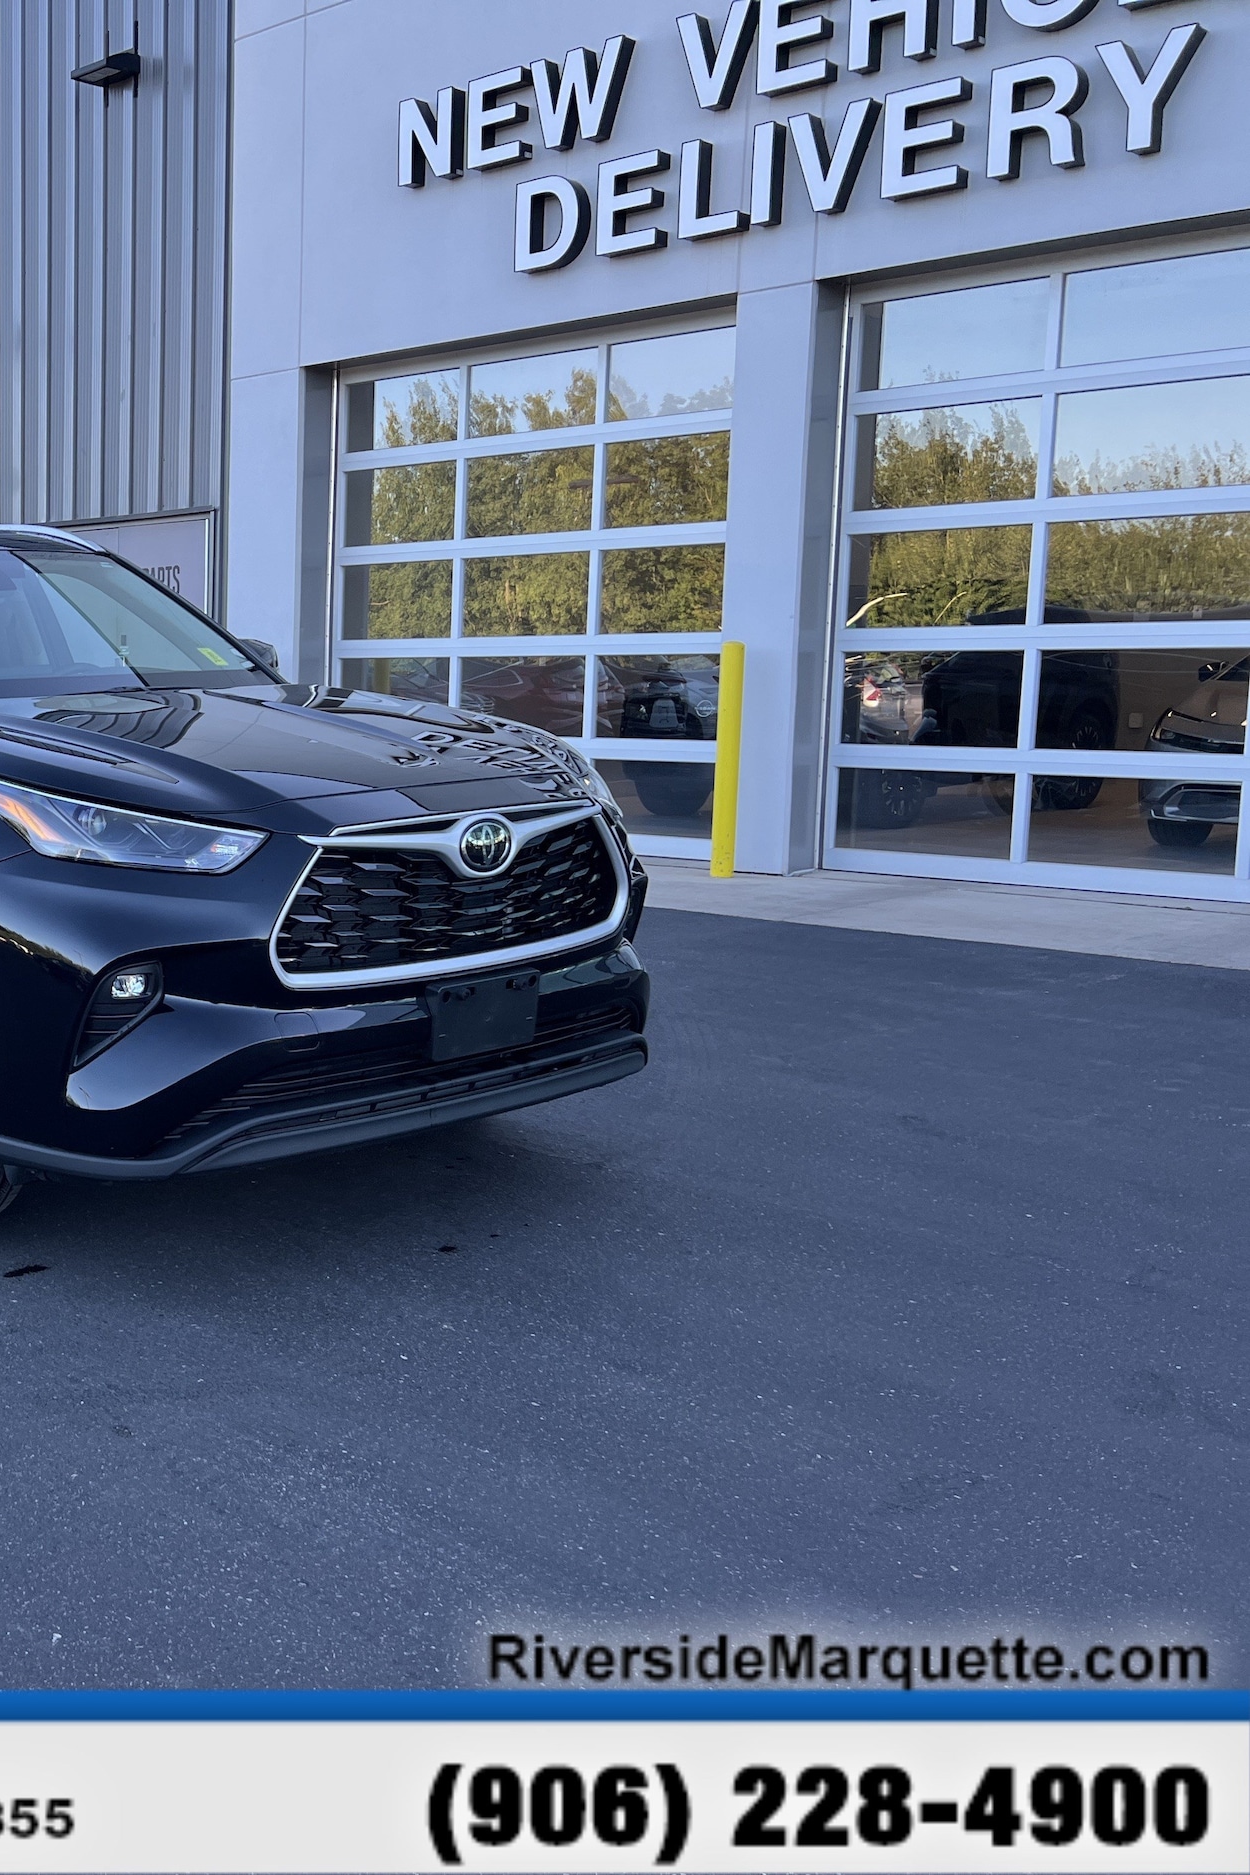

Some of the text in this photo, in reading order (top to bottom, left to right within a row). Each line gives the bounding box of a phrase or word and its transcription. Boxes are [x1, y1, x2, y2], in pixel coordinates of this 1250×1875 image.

[398, 35, 636, 188] NEW
[513, 23, 1207, 273] DELIVERY
[141, 565, 180, 594] RTS
